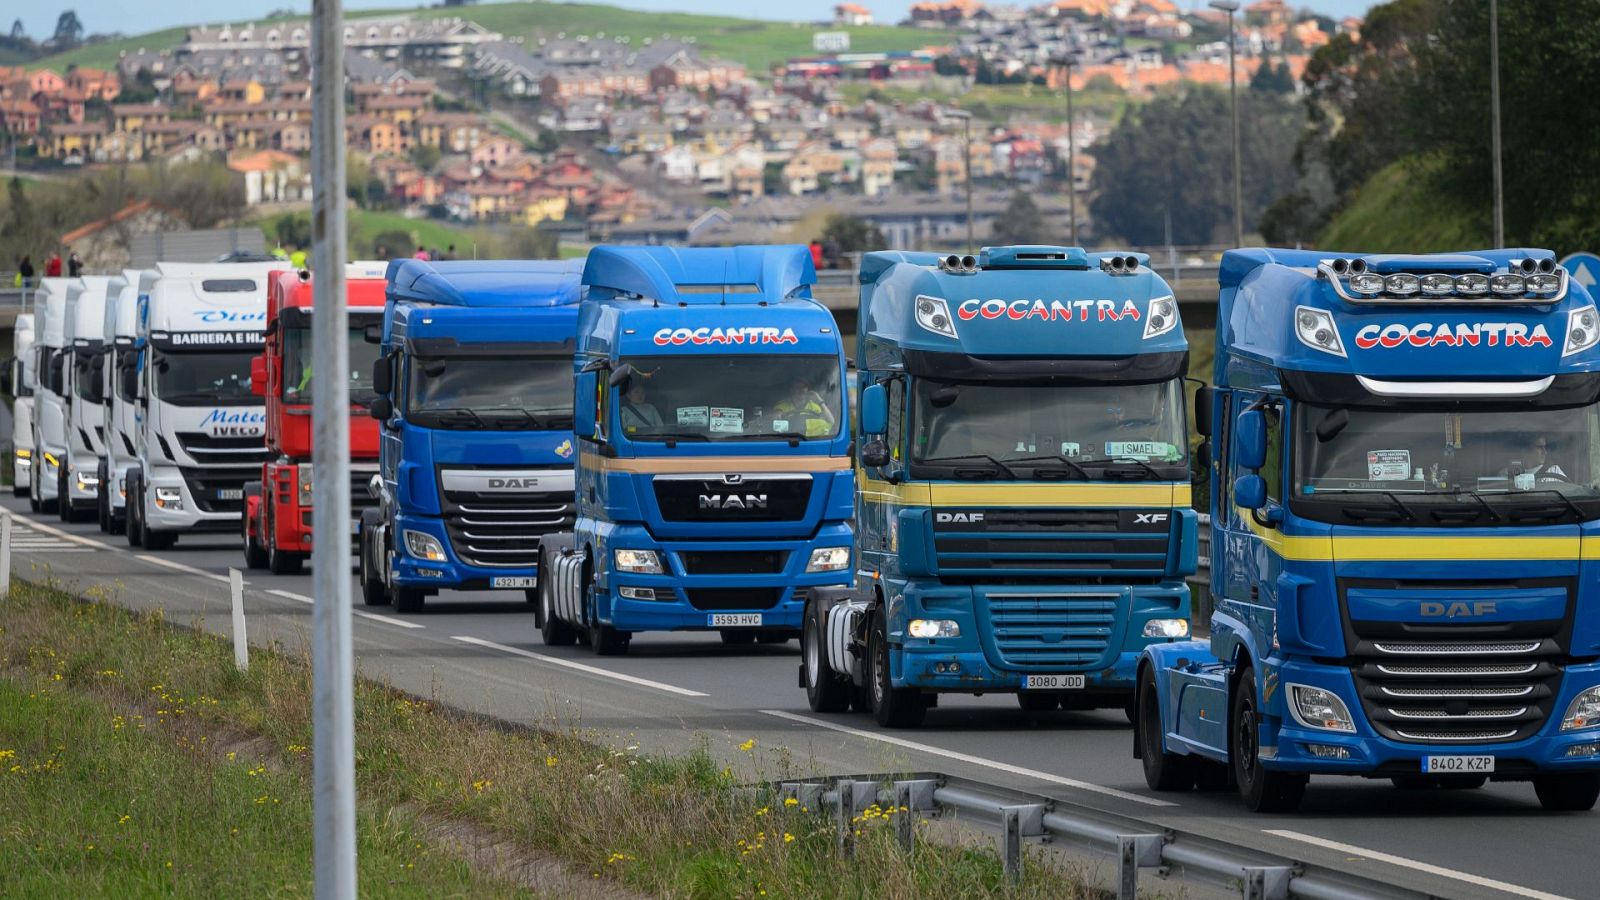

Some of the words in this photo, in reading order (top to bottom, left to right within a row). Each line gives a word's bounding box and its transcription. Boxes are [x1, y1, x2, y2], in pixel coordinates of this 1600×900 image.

[957, 299, 1141, 321] COCANTRA
[172, 333, 234, 344] BARRERA
[236, 333, 243, 343] E
[653, 327, 798, 345] COCANTRA
[1355, 322, 1553, 349] COCANTRA
[213, 427, 259, 435] IVECO
[1122, 443, 1157, 455] ISMAEL
[488, 479, 538, 488] DAF
[699, 495, 767, 508] MAN
[936, 513, 984, 522] DAF
[1133, 513, 1168, 523] XF
[1421, 602, 1497, 616] DAF
[715, 615, 739, 624] 3593
[741, 615, 759, 624] HVC
[1029, 676, 1057, 687] 3080
[1061, 676, 1082, 687] JDD
[1431, 758, 1463, 770] 8402
[1467, 757, 1491, 770] KZP
